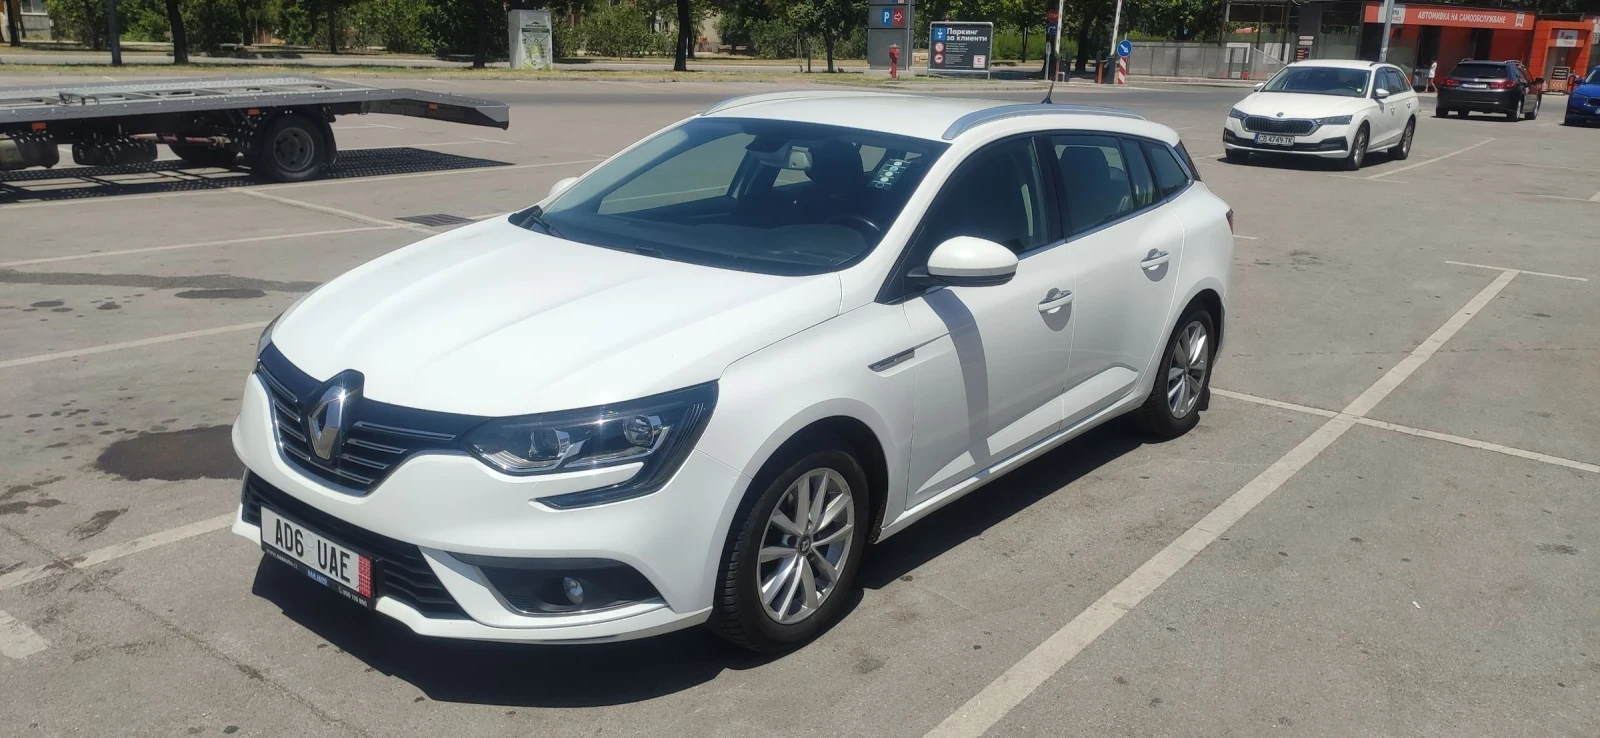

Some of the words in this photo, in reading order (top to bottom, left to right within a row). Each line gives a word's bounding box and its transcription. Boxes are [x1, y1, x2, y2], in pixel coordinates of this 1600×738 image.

[1417, 10, 1450, 21] АВТОМИВКА
[1450, 12, 1458, 21] НА
[1459, 13, 1507, 24] САМООБСЛУЖВАНЕ
[946, 27, 979, 37] Паркинг
[275, 518, 304, 557] AD6
[317, 539, 351, 584] UAE
